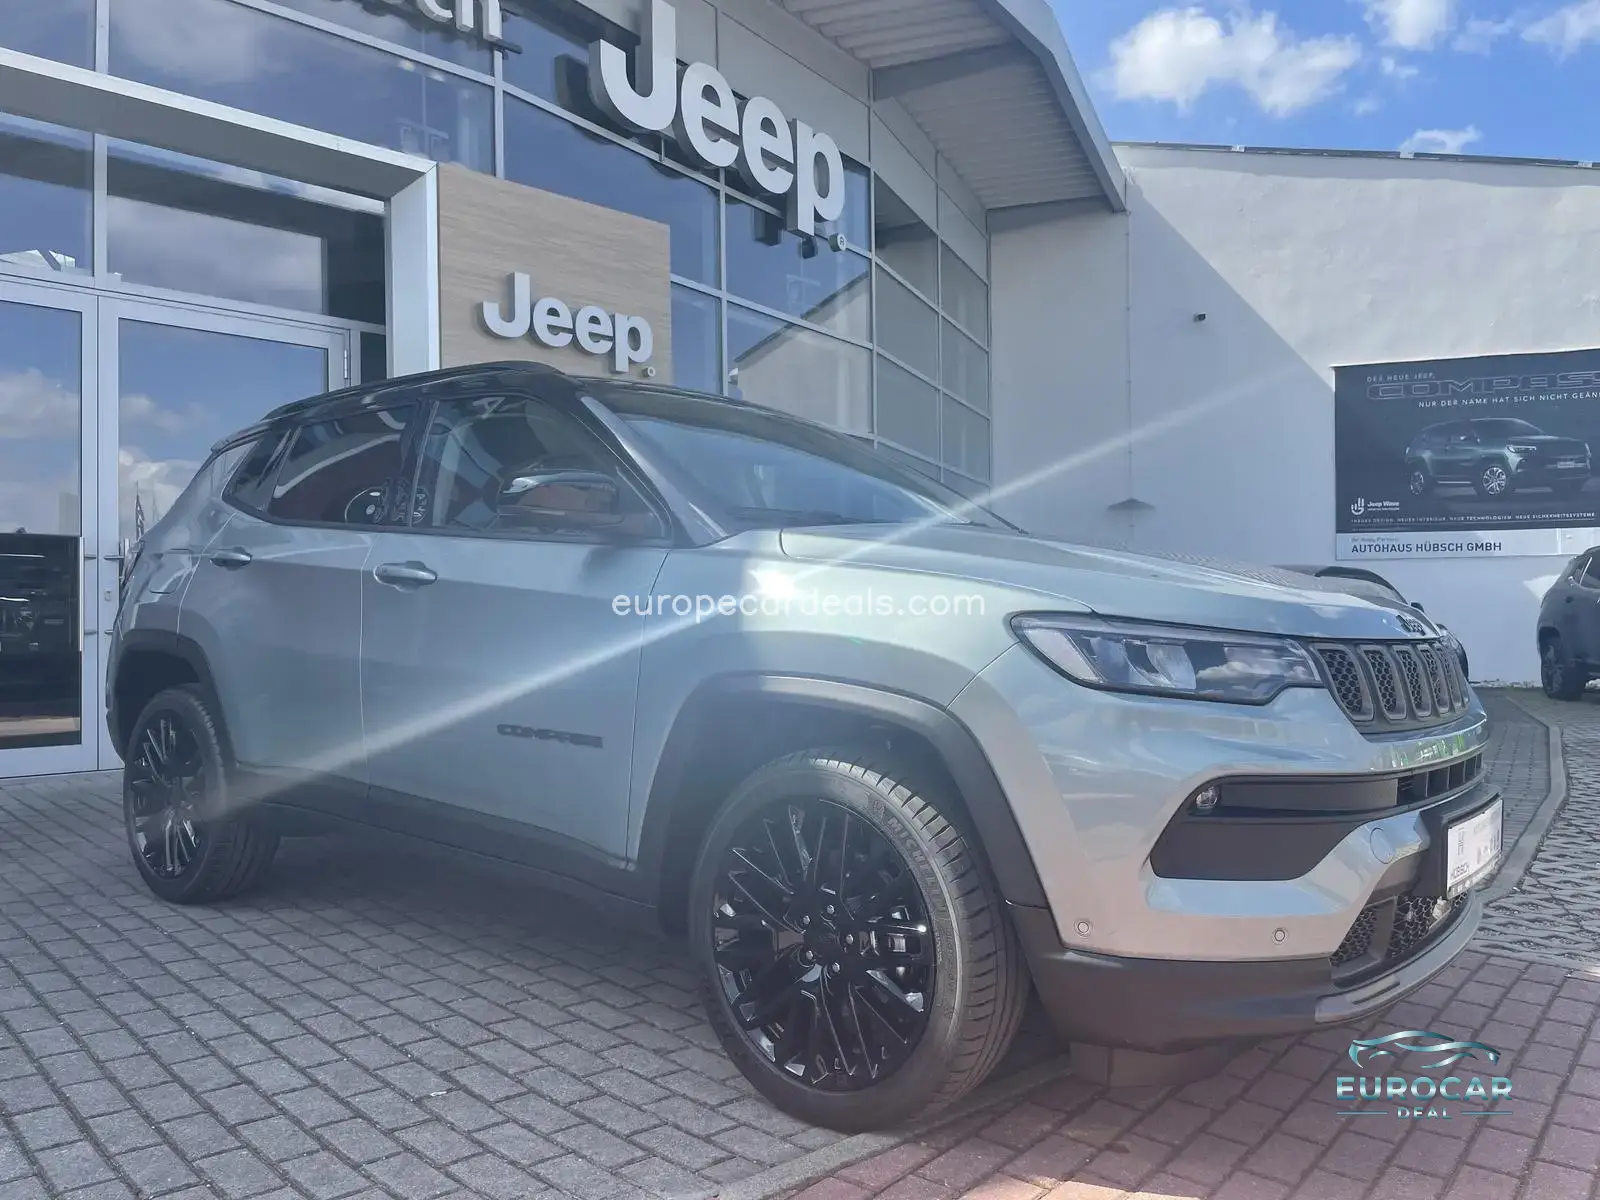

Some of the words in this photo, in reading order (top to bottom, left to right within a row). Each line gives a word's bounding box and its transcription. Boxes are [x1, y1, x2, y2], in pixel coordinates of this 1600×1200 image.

[589, 0, 845, 236] Jeep
[482, 271, 653, 373] Jeep
[1366, 371, 1600, 400] COMPAS
[1440, 399, 1458, 407] DER
[1461, 397, 1488, 405] NAME
[1513, 394, 1535, 402] SICH
[1539, 392, 1568, 401] NICHT
[1571, 390, 1600, 399] GEÄN
[1382, 499, 1400, 507] Wave
[1351, 543, 1413, 554] AUTOHAUS
[1415, 539, 1463, 553] HÜBSCH
[1466, 541, 1502, 552] GMBH
